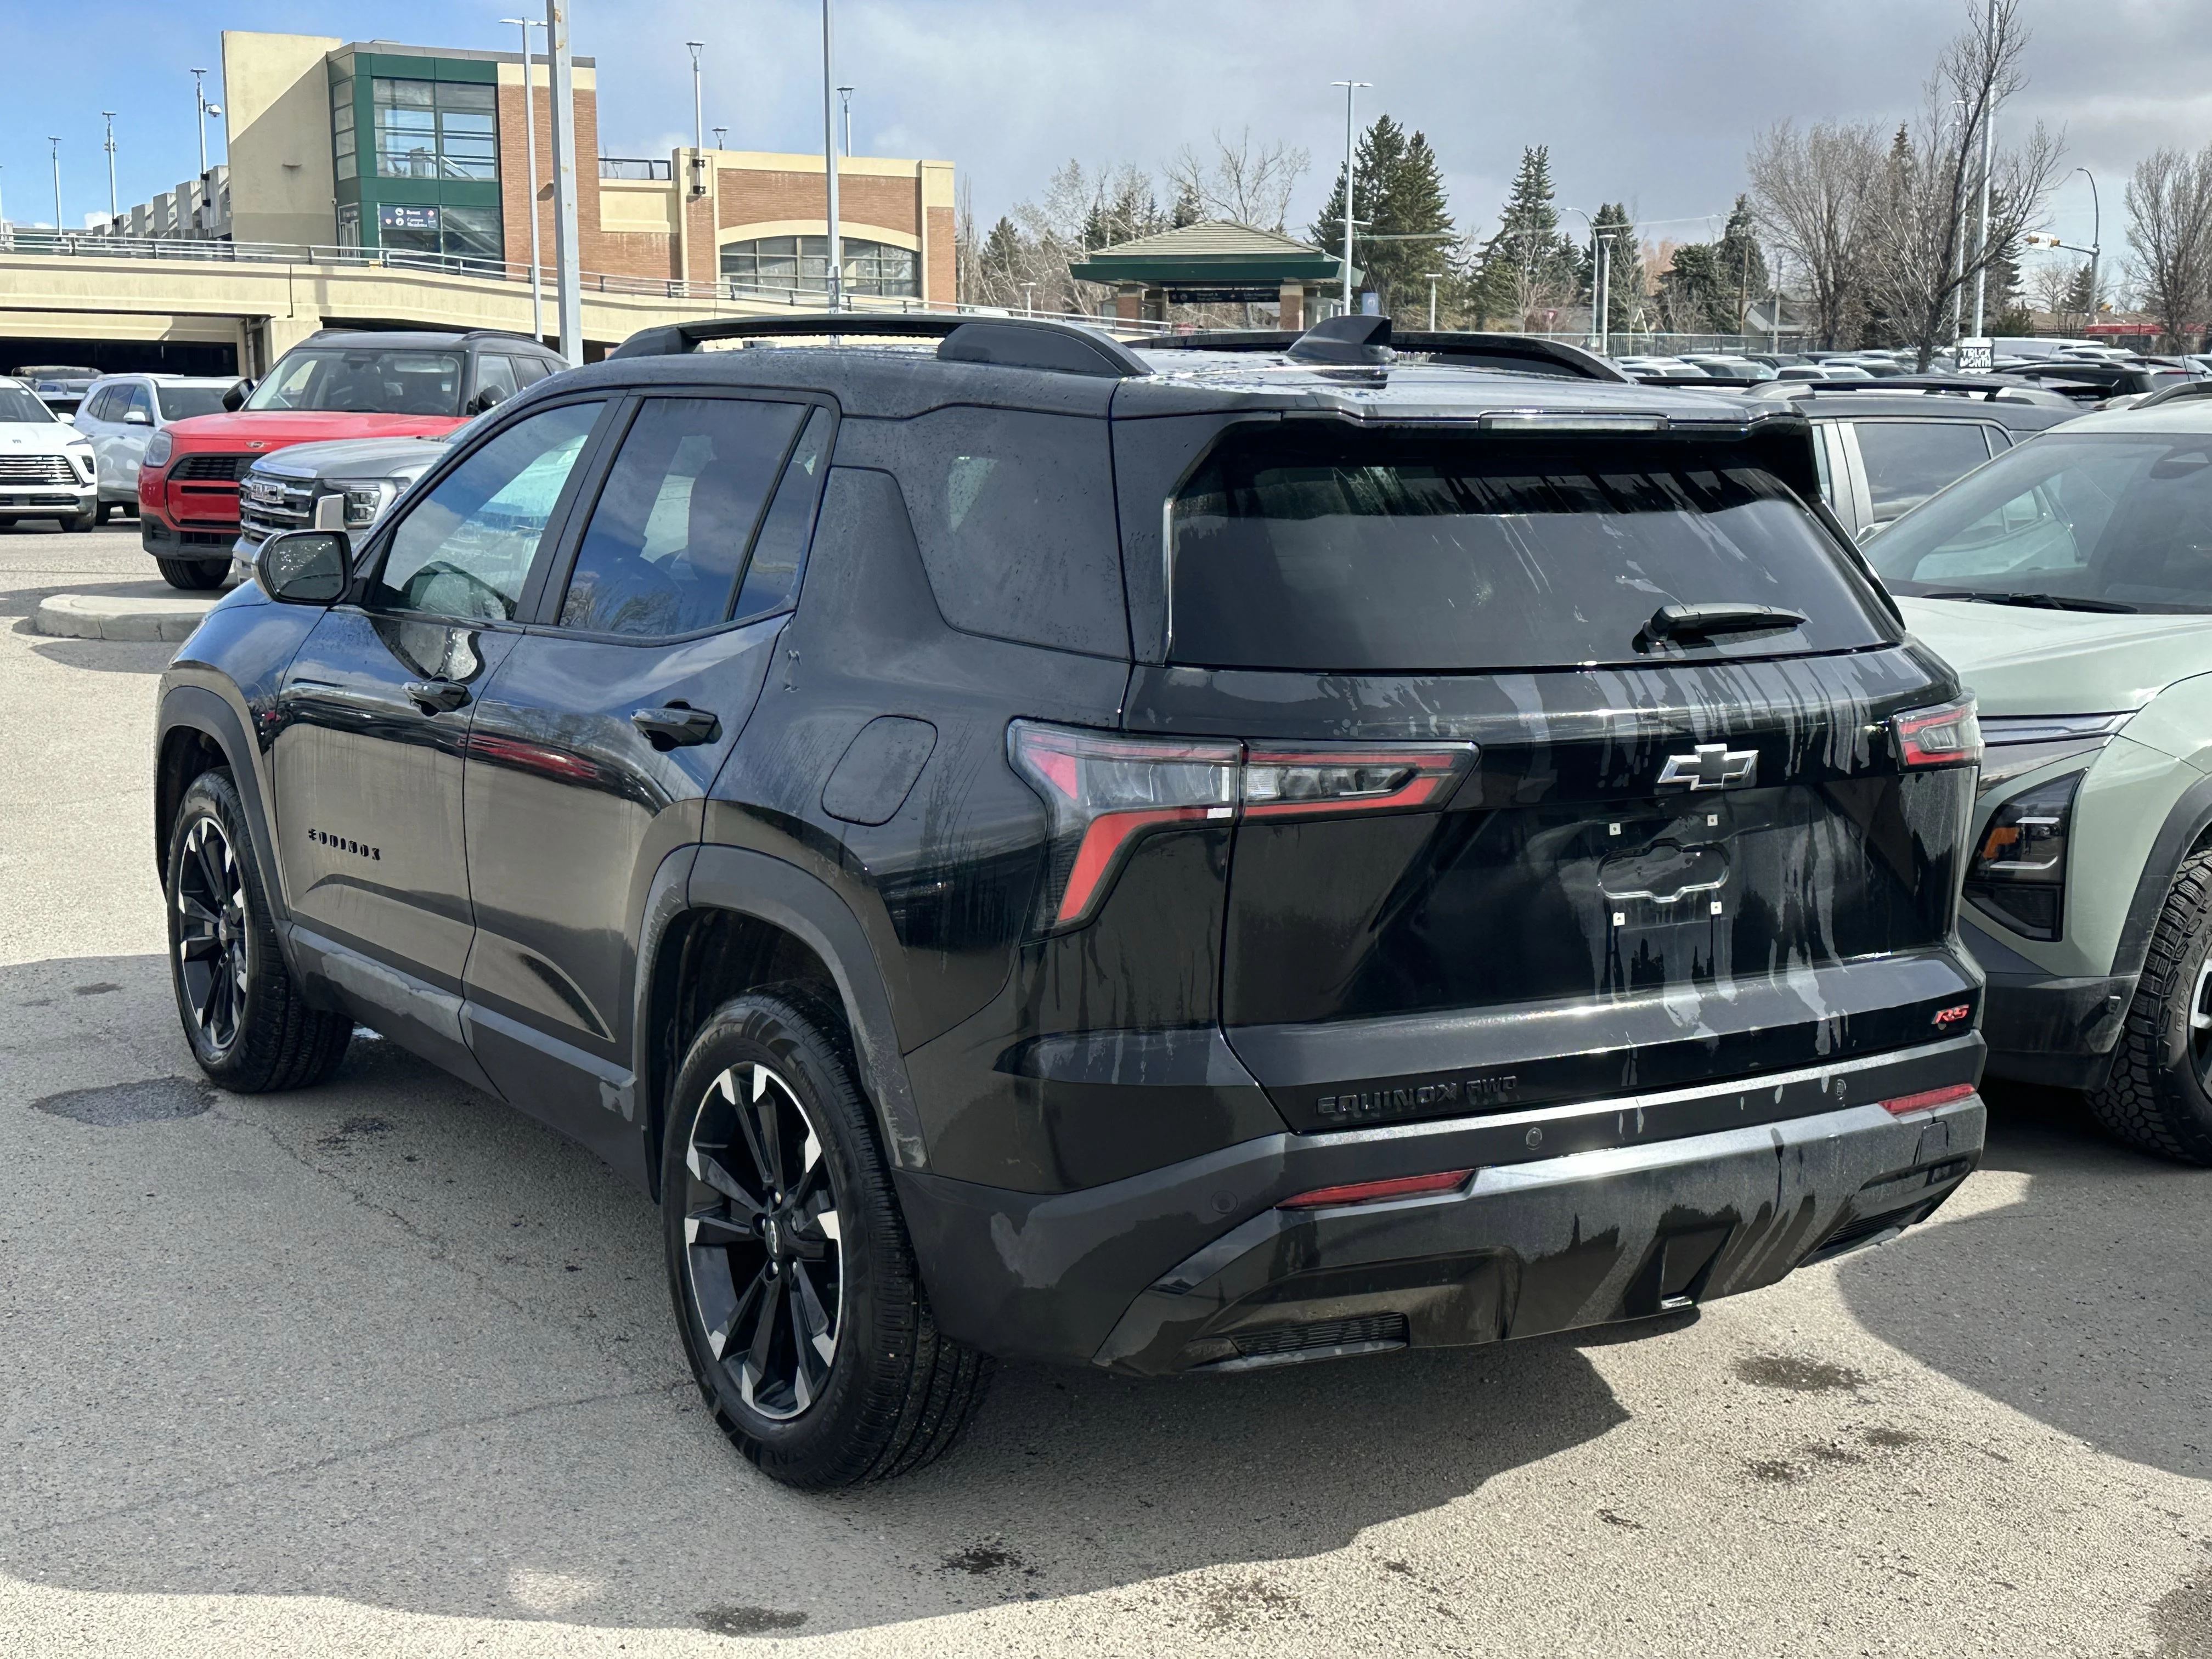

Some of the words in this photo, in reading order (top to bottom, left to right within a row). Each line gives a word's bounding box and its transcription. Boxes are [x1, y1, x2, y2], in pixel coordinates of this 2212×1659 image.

[1960, 357, 1991, 367] MONTH
[1961, 347, 1990, 358] TRUCK
[308, 828, 381, 861] EQUINOX
[1932, 1004, 1970, 1024] RS
[1317, 1082, 1457, 1114] EQUINOX
[1465, 1075, 1517, 1097] AWD
